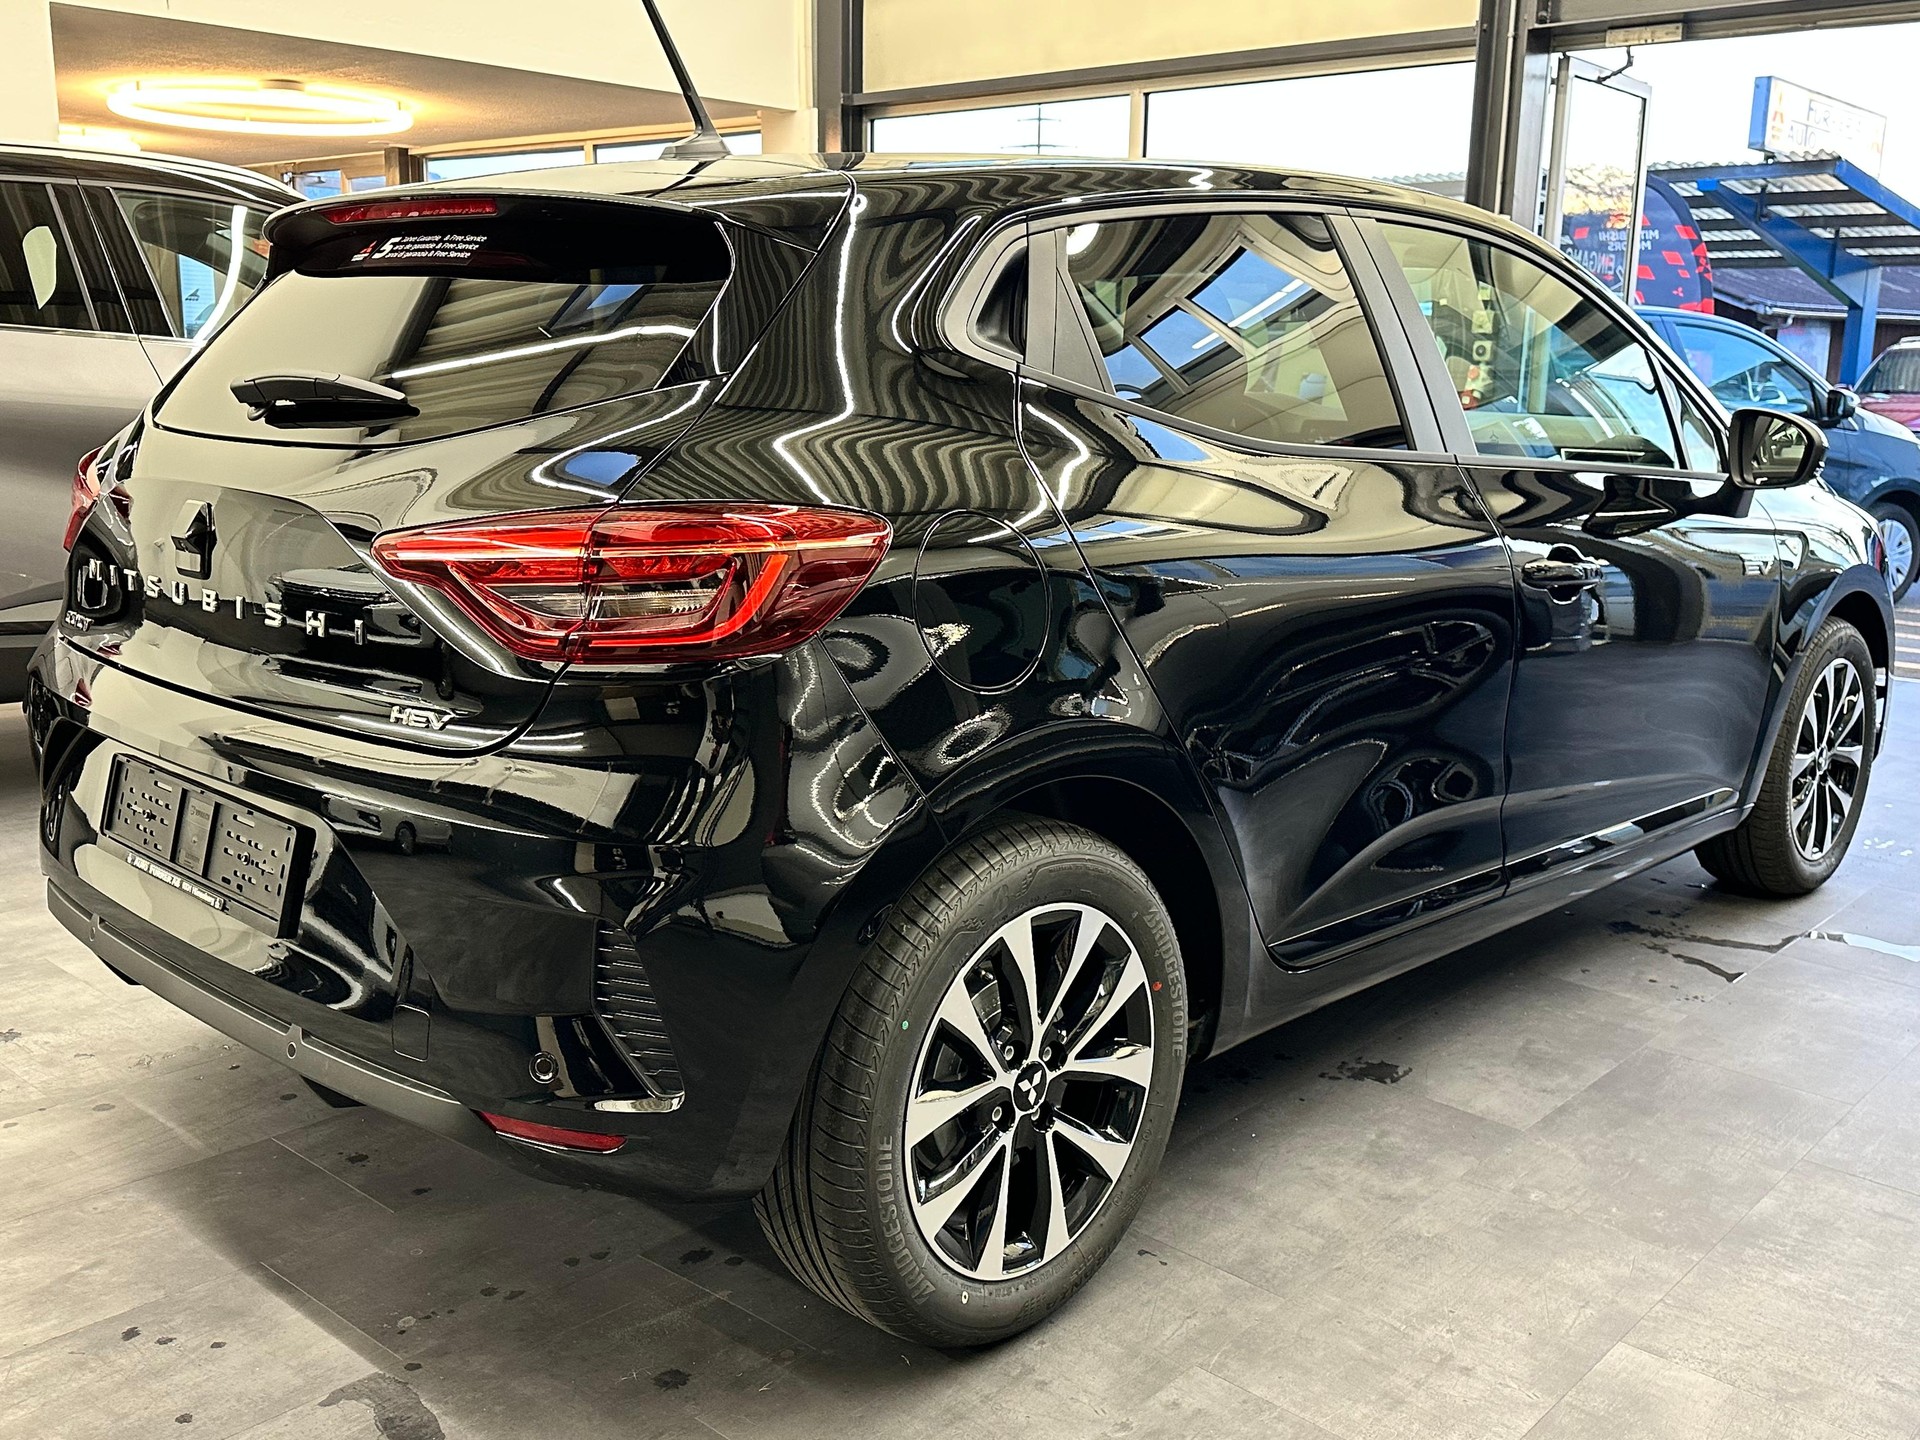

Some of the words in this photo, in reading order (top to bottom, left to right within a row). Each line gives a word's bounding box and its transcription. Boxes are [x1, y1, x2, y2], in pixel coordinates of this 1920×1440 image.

[1787, 120, 1818, 149] AUTO
[372, 237, 402, 259] 5
[89, 558, 365, 646] MITSUBISHI
[390, 705, 454, 731] HEV
[1145, 904, 1184, 1057] BRIDGESTONE
[874, 1133, 936, 1311] BRIDGESTONE
